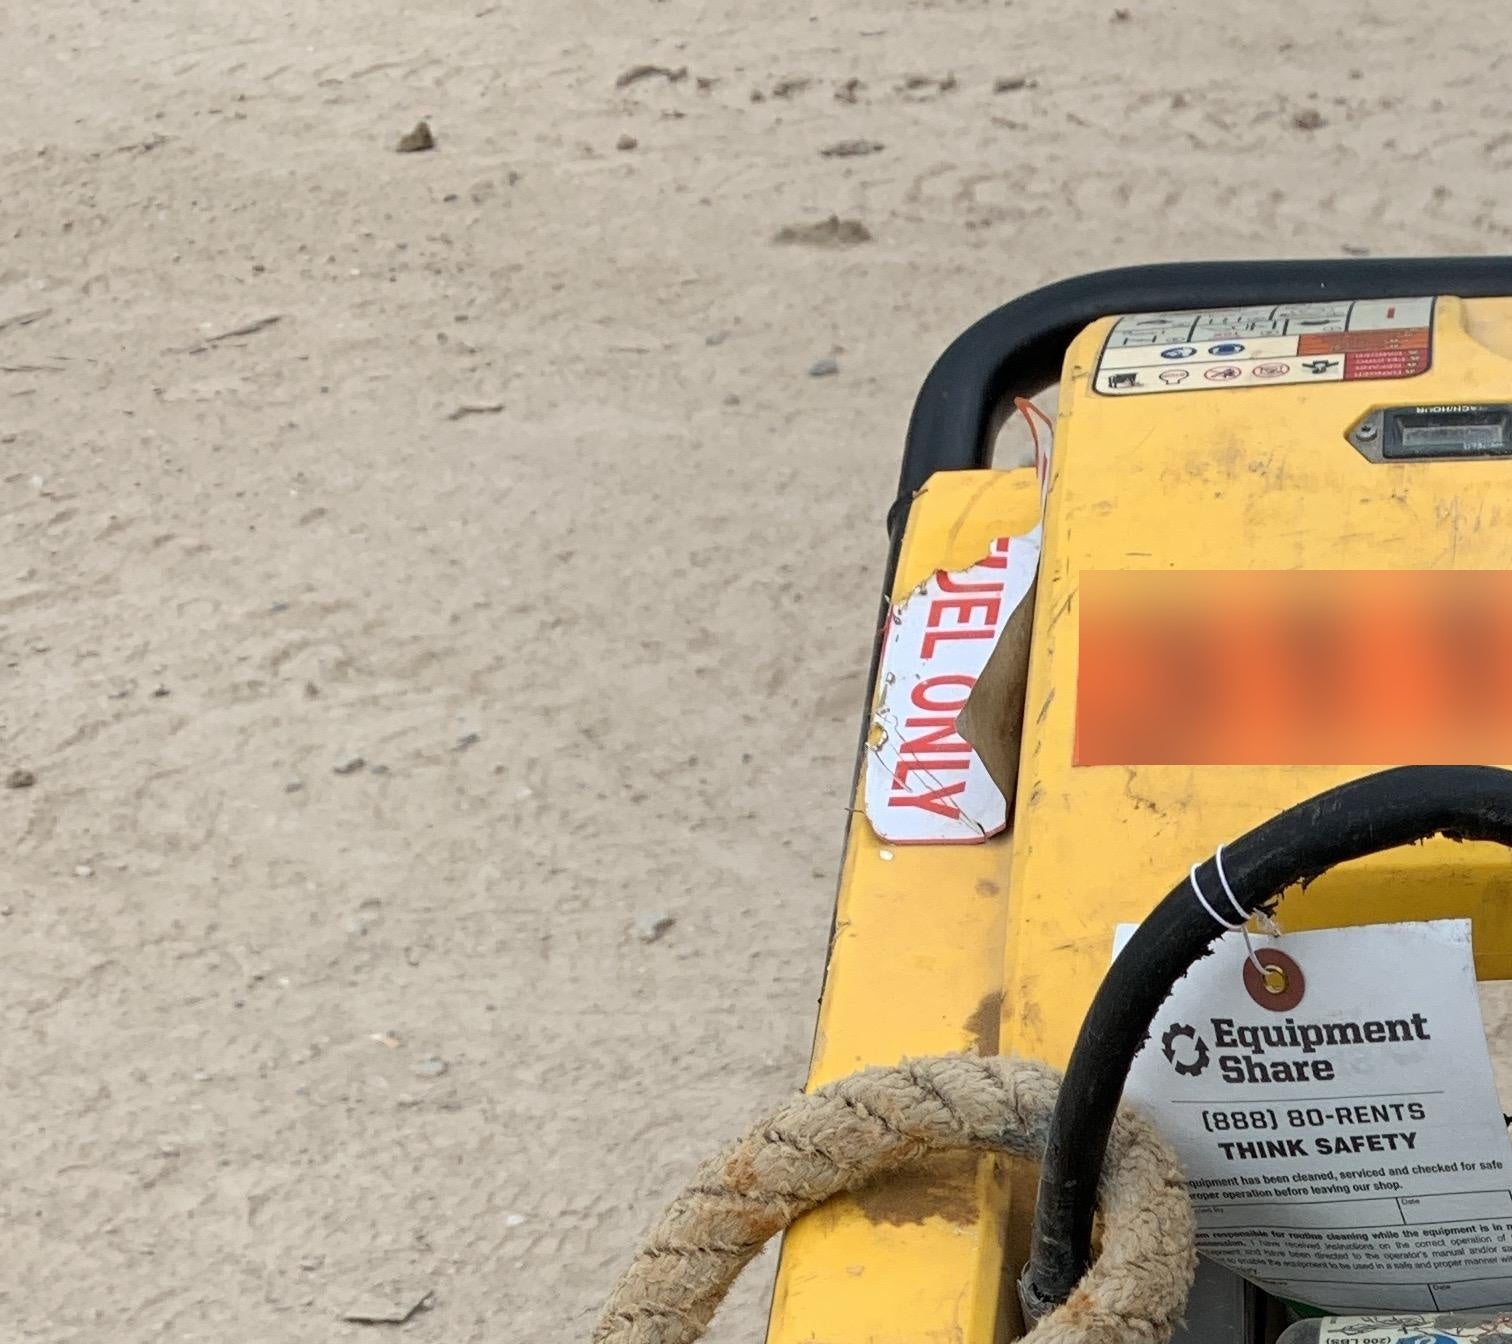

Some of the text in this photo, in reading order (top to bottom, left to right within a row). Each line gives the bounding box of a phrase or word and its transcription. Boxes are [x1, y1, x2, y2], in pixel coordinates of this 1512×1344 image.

[887, 536, 1013, 820] UEL ONLY
[1211, 1013, 1431, 1053] Equipment
[1219, 1055, 1336, 1084] Share
[1202, 1102, 1426, 1132] (888) 80-RENTS
[1218, 1132, 1417, 1160] THINK SAFETY
[1186, 1160, 1503, 1190] quipment has been cleaned, serviced and checked for safe
[1188, 1180, 1403, 1202] roper operation before leaving our shop.
[1271, 1230, 1285, 1239] for
[1326, 1231, 1369, 1241] cleaning
[1371, 1230, 1399, 1240] while
[1402, 1229, 1419, 1238] the
[1422, 1225, 1477, 1238] equipment
[1479, 1224, 1489, 1233] is
[1492, 1223, 1503, 1232] in
[1414, 1239, 1446, 1249] correct
[1450, 1235, 1492, 1246] operation
[1496, 1233, 1506, 1242] of
[1383, 1250, 1428, 1260] operator's
[1432, 1248, 1465, 1258] manual
[1469, 1246, 1498, 1255] and/or
[1415, 1260, 1432, 1269] and
[1433, 1259, 1462, 1269] proper
[1465, 1257, 1498, 1266] manner
